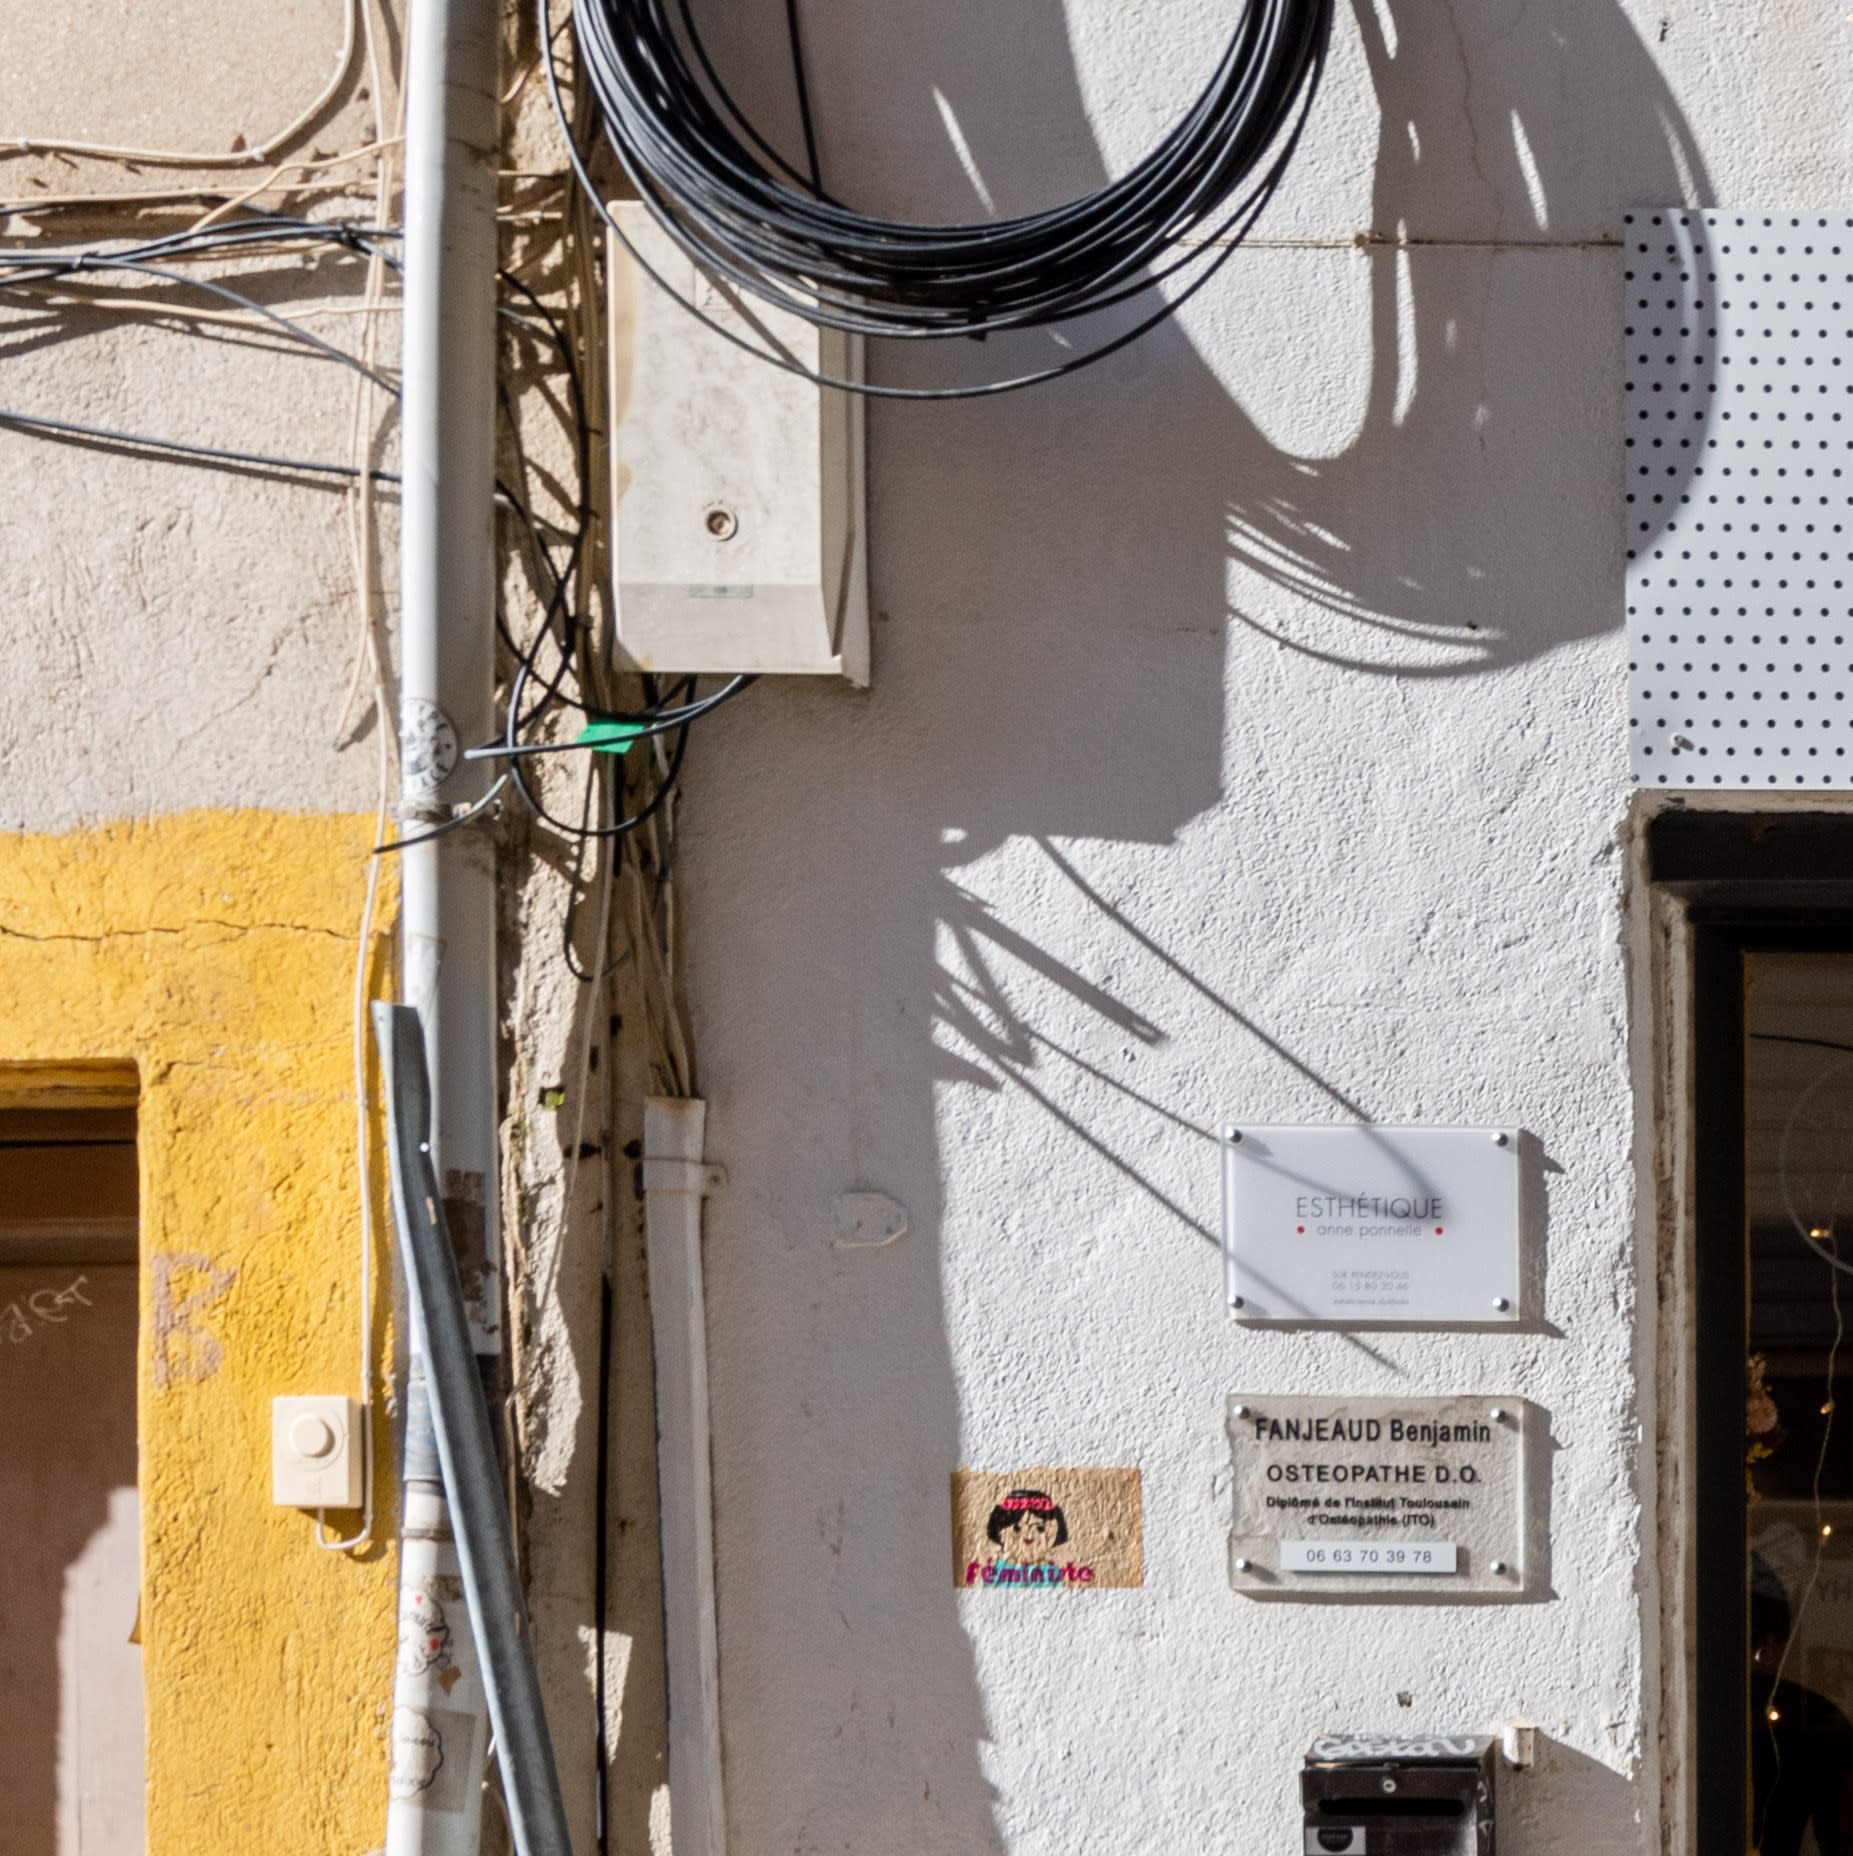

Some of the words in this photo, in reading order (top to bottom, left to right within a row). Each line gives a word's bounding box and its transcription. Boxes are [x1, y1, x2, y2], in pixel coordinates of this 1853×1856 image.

[1296, 1191, 1443, 1219] ESTHÉTIQUE
[1317, 1225, 1353, 1236] anne
[1359, 1223, 1422, 1239] ponnelle
[1255, 1417, 1381, 1442] FANJEAUD
[1390, 1416, 1491, 1447] Benjamin
[1266, 1464, 1427, 1484] OSTEOPATHE
[1434, 1464, 1482, 1485] D.O.
[1266, 1495, 1321, 1511] Diplômé
[1324, 1497, 1341, 1510] de
[1400, 1497, 1470, 1511] Toulousain
[1307, 1513, 1398, 1528] d'Ostéopathie
[1305, 1549, 1326, 1563] 06
[1332, 1549, 1353, 1563] 63
[1359, 1549, 1379, 1563] 70
[1386, 1549, 1406, 1563] 39
[1412, 1549, 1433, 1563] 78
